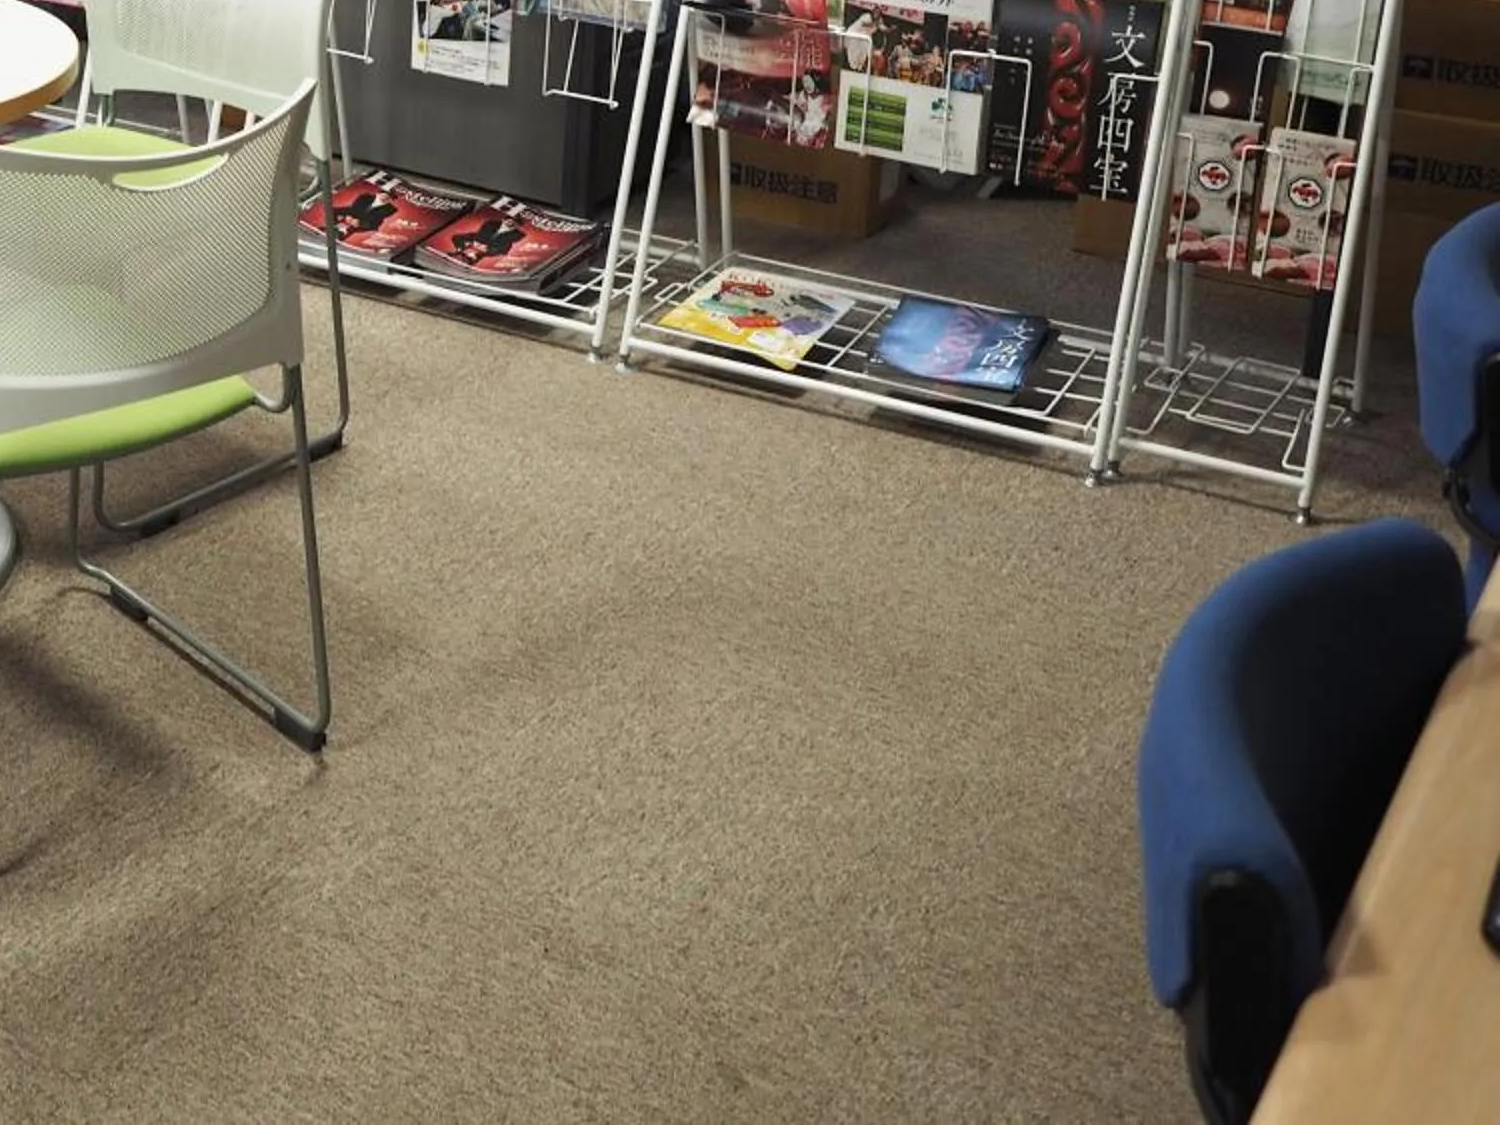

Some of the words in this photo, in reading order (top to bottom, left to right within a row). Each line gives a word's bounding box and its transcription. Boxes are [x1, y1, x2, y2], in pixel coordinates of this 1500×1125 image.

[1089, 24, 1147, 194] 文房四宝
[740, 166, 838, 205] 取扱注意
